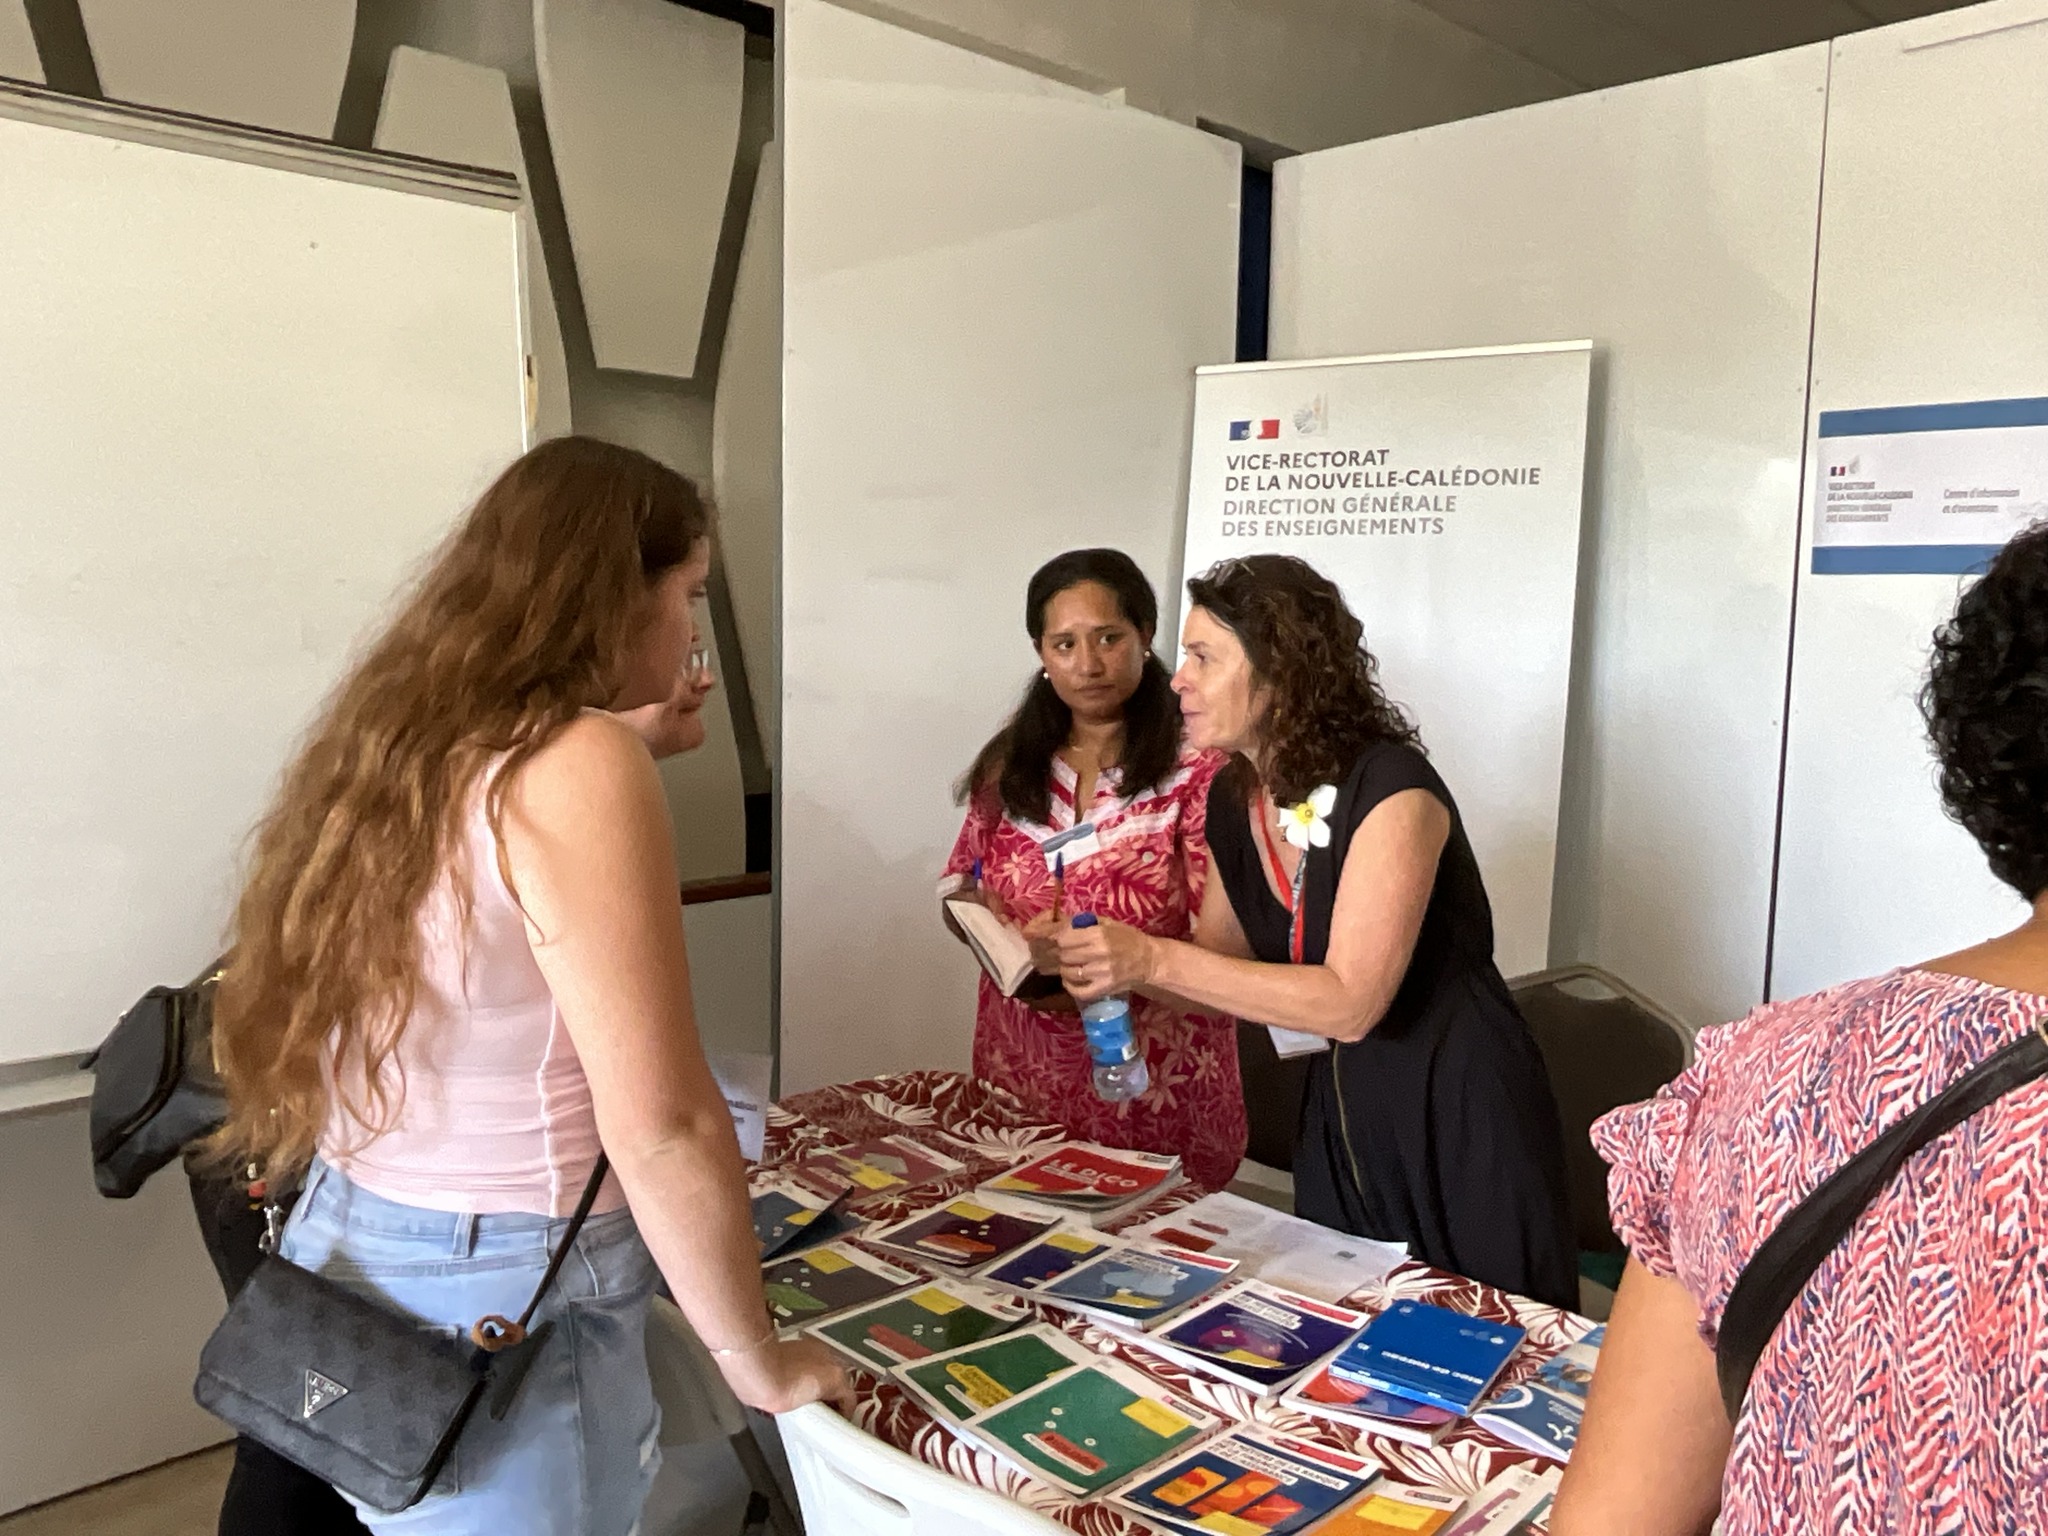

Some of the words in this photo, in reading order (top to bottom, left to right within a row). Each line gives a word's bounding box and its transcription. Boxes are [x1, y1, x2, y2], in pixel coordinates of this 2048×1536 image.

[1226, 449, 1390, 471] VICE-RECTORAT
[1225, 475, 1250, 491] DE
[1257, 474, 1281, 491] LA
[1288, 465, 1541, 490] NOUVELLE-CALÉDONIE
[1223, 498, 1336, 515] DIRECTION
[1342, 491, 1457, 513] GÉNÉRALE
[1222, 521, 1258, 537] DES
[1264, 517, 1445, 536] ENSEIGNEMENTS
